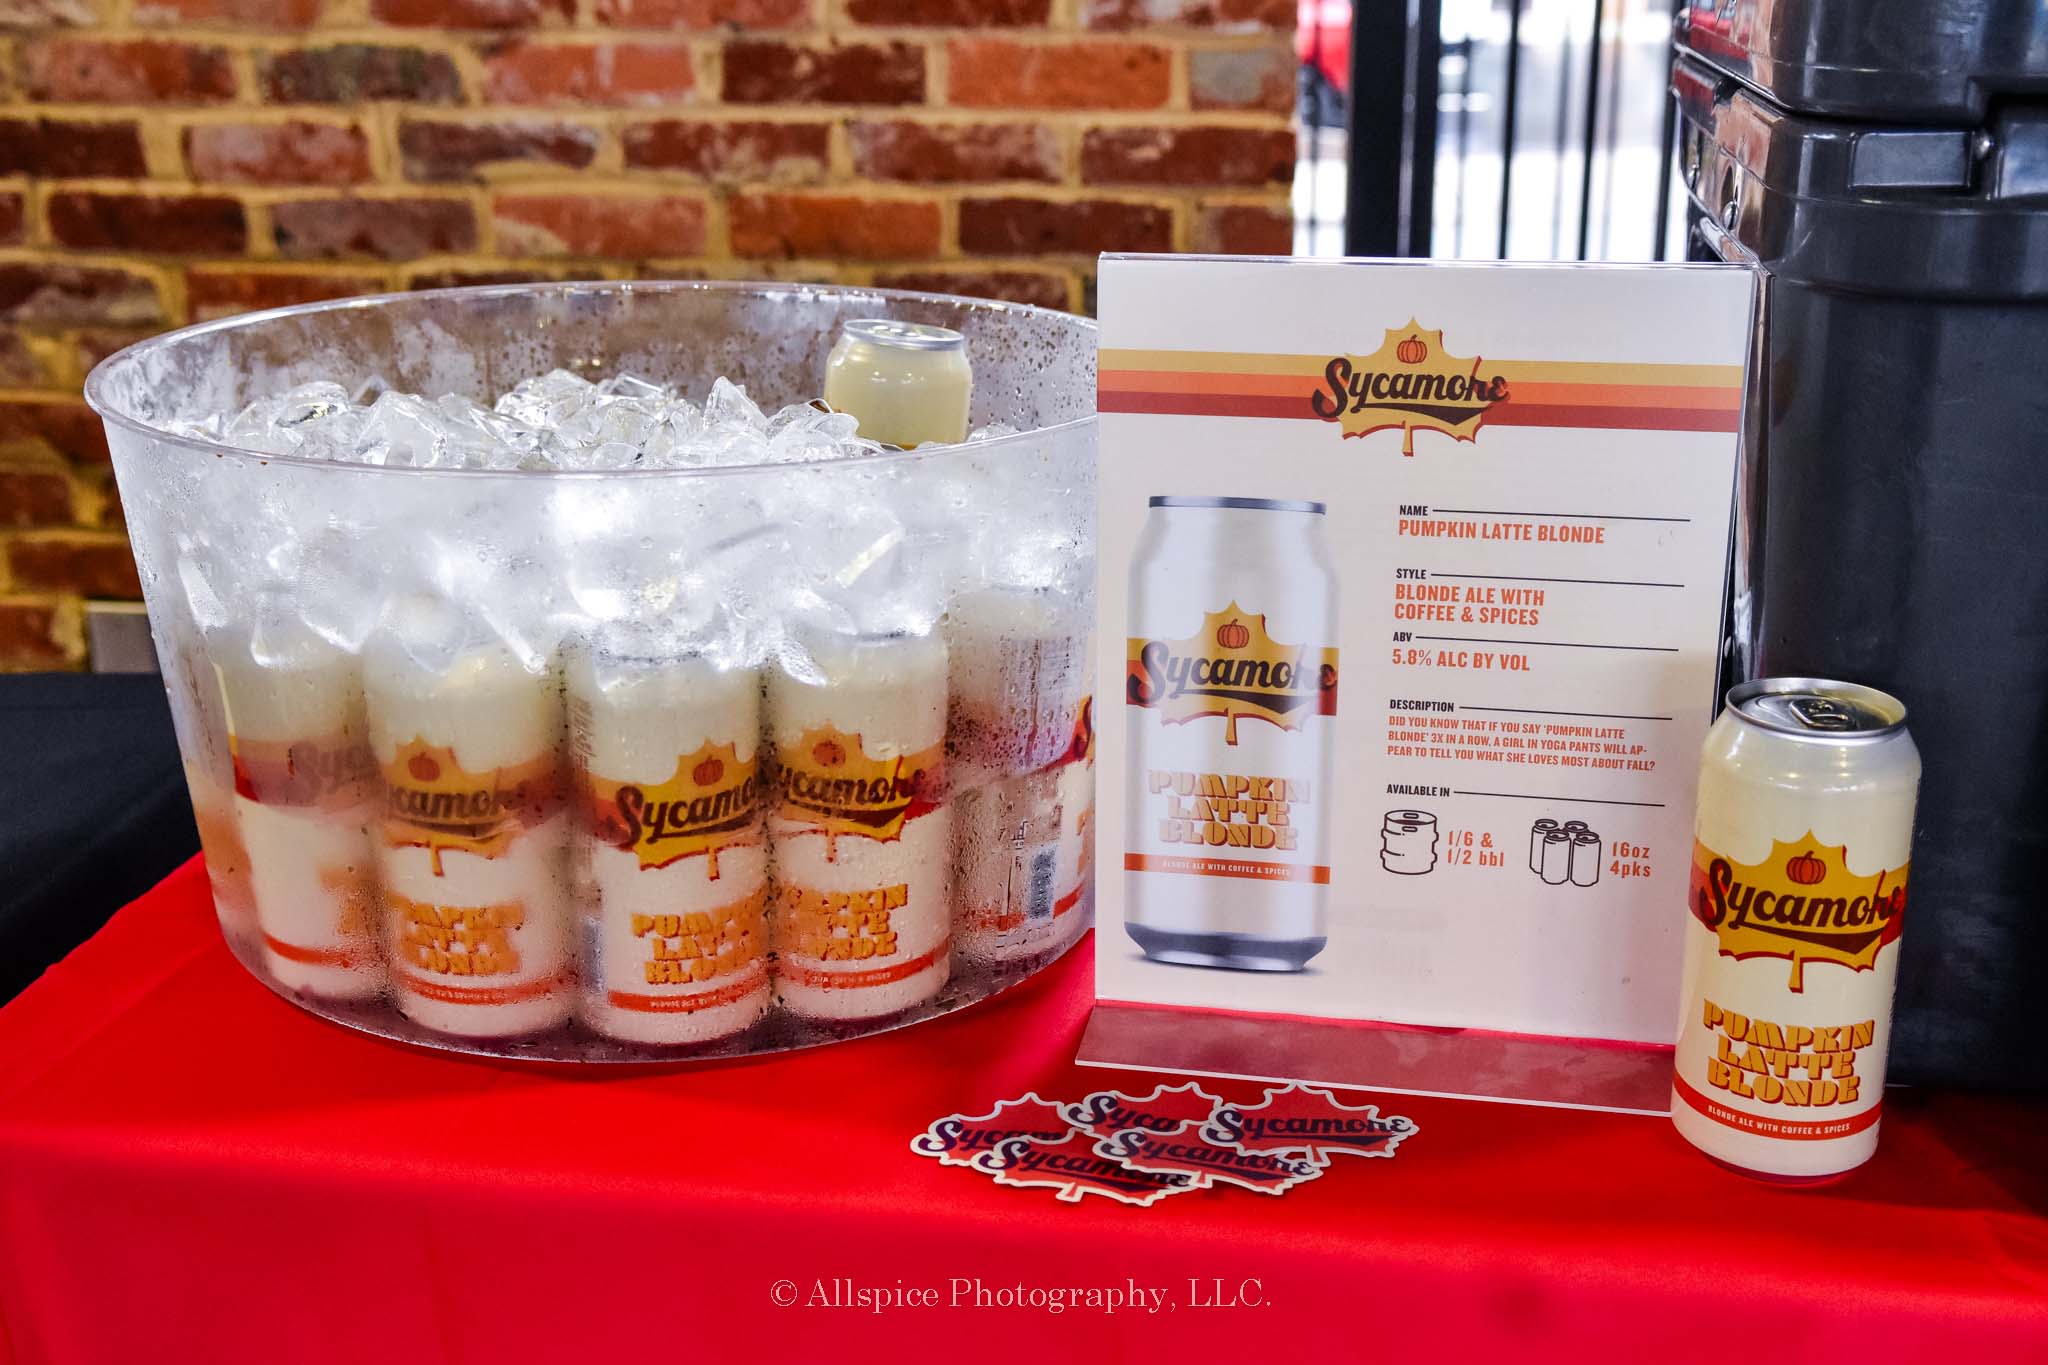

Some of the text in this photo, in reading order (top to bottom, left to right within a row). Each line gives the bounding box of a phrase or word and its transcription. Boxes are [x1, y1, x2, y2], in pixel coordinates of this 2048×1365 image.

[1312, 356, 1510, 419] Sycamore
[1399, 504, 1429, 516] NAME
[1398, 519, 1605, 544] PUMPKIN LATTE BLONDE
[1396, 568, 1427, 580] STYLE
[1395, 583, 1545, 606] BLONDE ALE WITH
[1394, 603, 1539, 626] COFFEE & SPICES
[1393, 632, 1412, 642] ABV
[1392, 649, 1530, 672] 5.8% ALC BY VOL
[1389, 699, 1454, 712] DESCRIPTION
[1389, 715, 1406, 726] DID
[1408, 717, 1427, 727] YOU
[1430, 718, 1459, 729] KNOW
[1462, 720, 1487, 731] THAT
[1489, 721, 1498, 731] IF
[1500, 722, 1520, 733] YOU
[1522, 723, 1541, 734] SAY
[1595, 728, 1625, 739] LATTE
[1431, 733, 1443, 743] 3X
[1446, 734, 1456, 744] IN
[1459, 734, 1465, 744] A
[1467, 735, 1491, 747] ROW,
[1494, 736, 1500, 747] A
[1502, 737, 1524, 748] GIRL
[1528, 739, 1538, 749] IN
[1541, 739, 1566, 751] YOGA
[1569, 741, 1600, 753] PANTS
[1603, 743, 1627, 754] WILL
[1630, 745, 1647, 755] AP-
[1388, 745, 1656, 771] PEAR TO TELL YOU WHAT SHE LOVES MOST ABOUT FALL?
[1148, 769, 1311, 804] PUMPKIN
[1386, 784, 1450, 797] AVAILABLE IN
[1167, 796, 1291, 826] LATTE
[1158, 818, 1298, 850] BLONDE
[1448, 830, 1494, 848] 1/6 &
[1447, 849, 1505, 867] 1/2 bbl
[1612, 841, 1650, 859] 16oz
[1193, 862, 1206, 871] ALE
[1208, 863, 1226, 871] WITH
[1228, 864, 1255, 874] COFFEE
[1257, 866, 1263, 874] &
[1265, 866, 1291, 877] SPICES
[1609, 860, 1651, 879] 4pks
[1699, 857, 1901, 930] Sycamore
[1704, 998, 1875, 1054] PUMPKIN
[1718, 1034, 1856, 1080] LATTE
[1707, 1055, 1860, 1107] BLONDE
[1206, 1109, 1412, 1143] Sycamore
[1708, 1105, 1850, 1135] BLONDE ALE WITH COFFEE & SPICES
[1101, 1132, 1315, 1176] Sycamore
